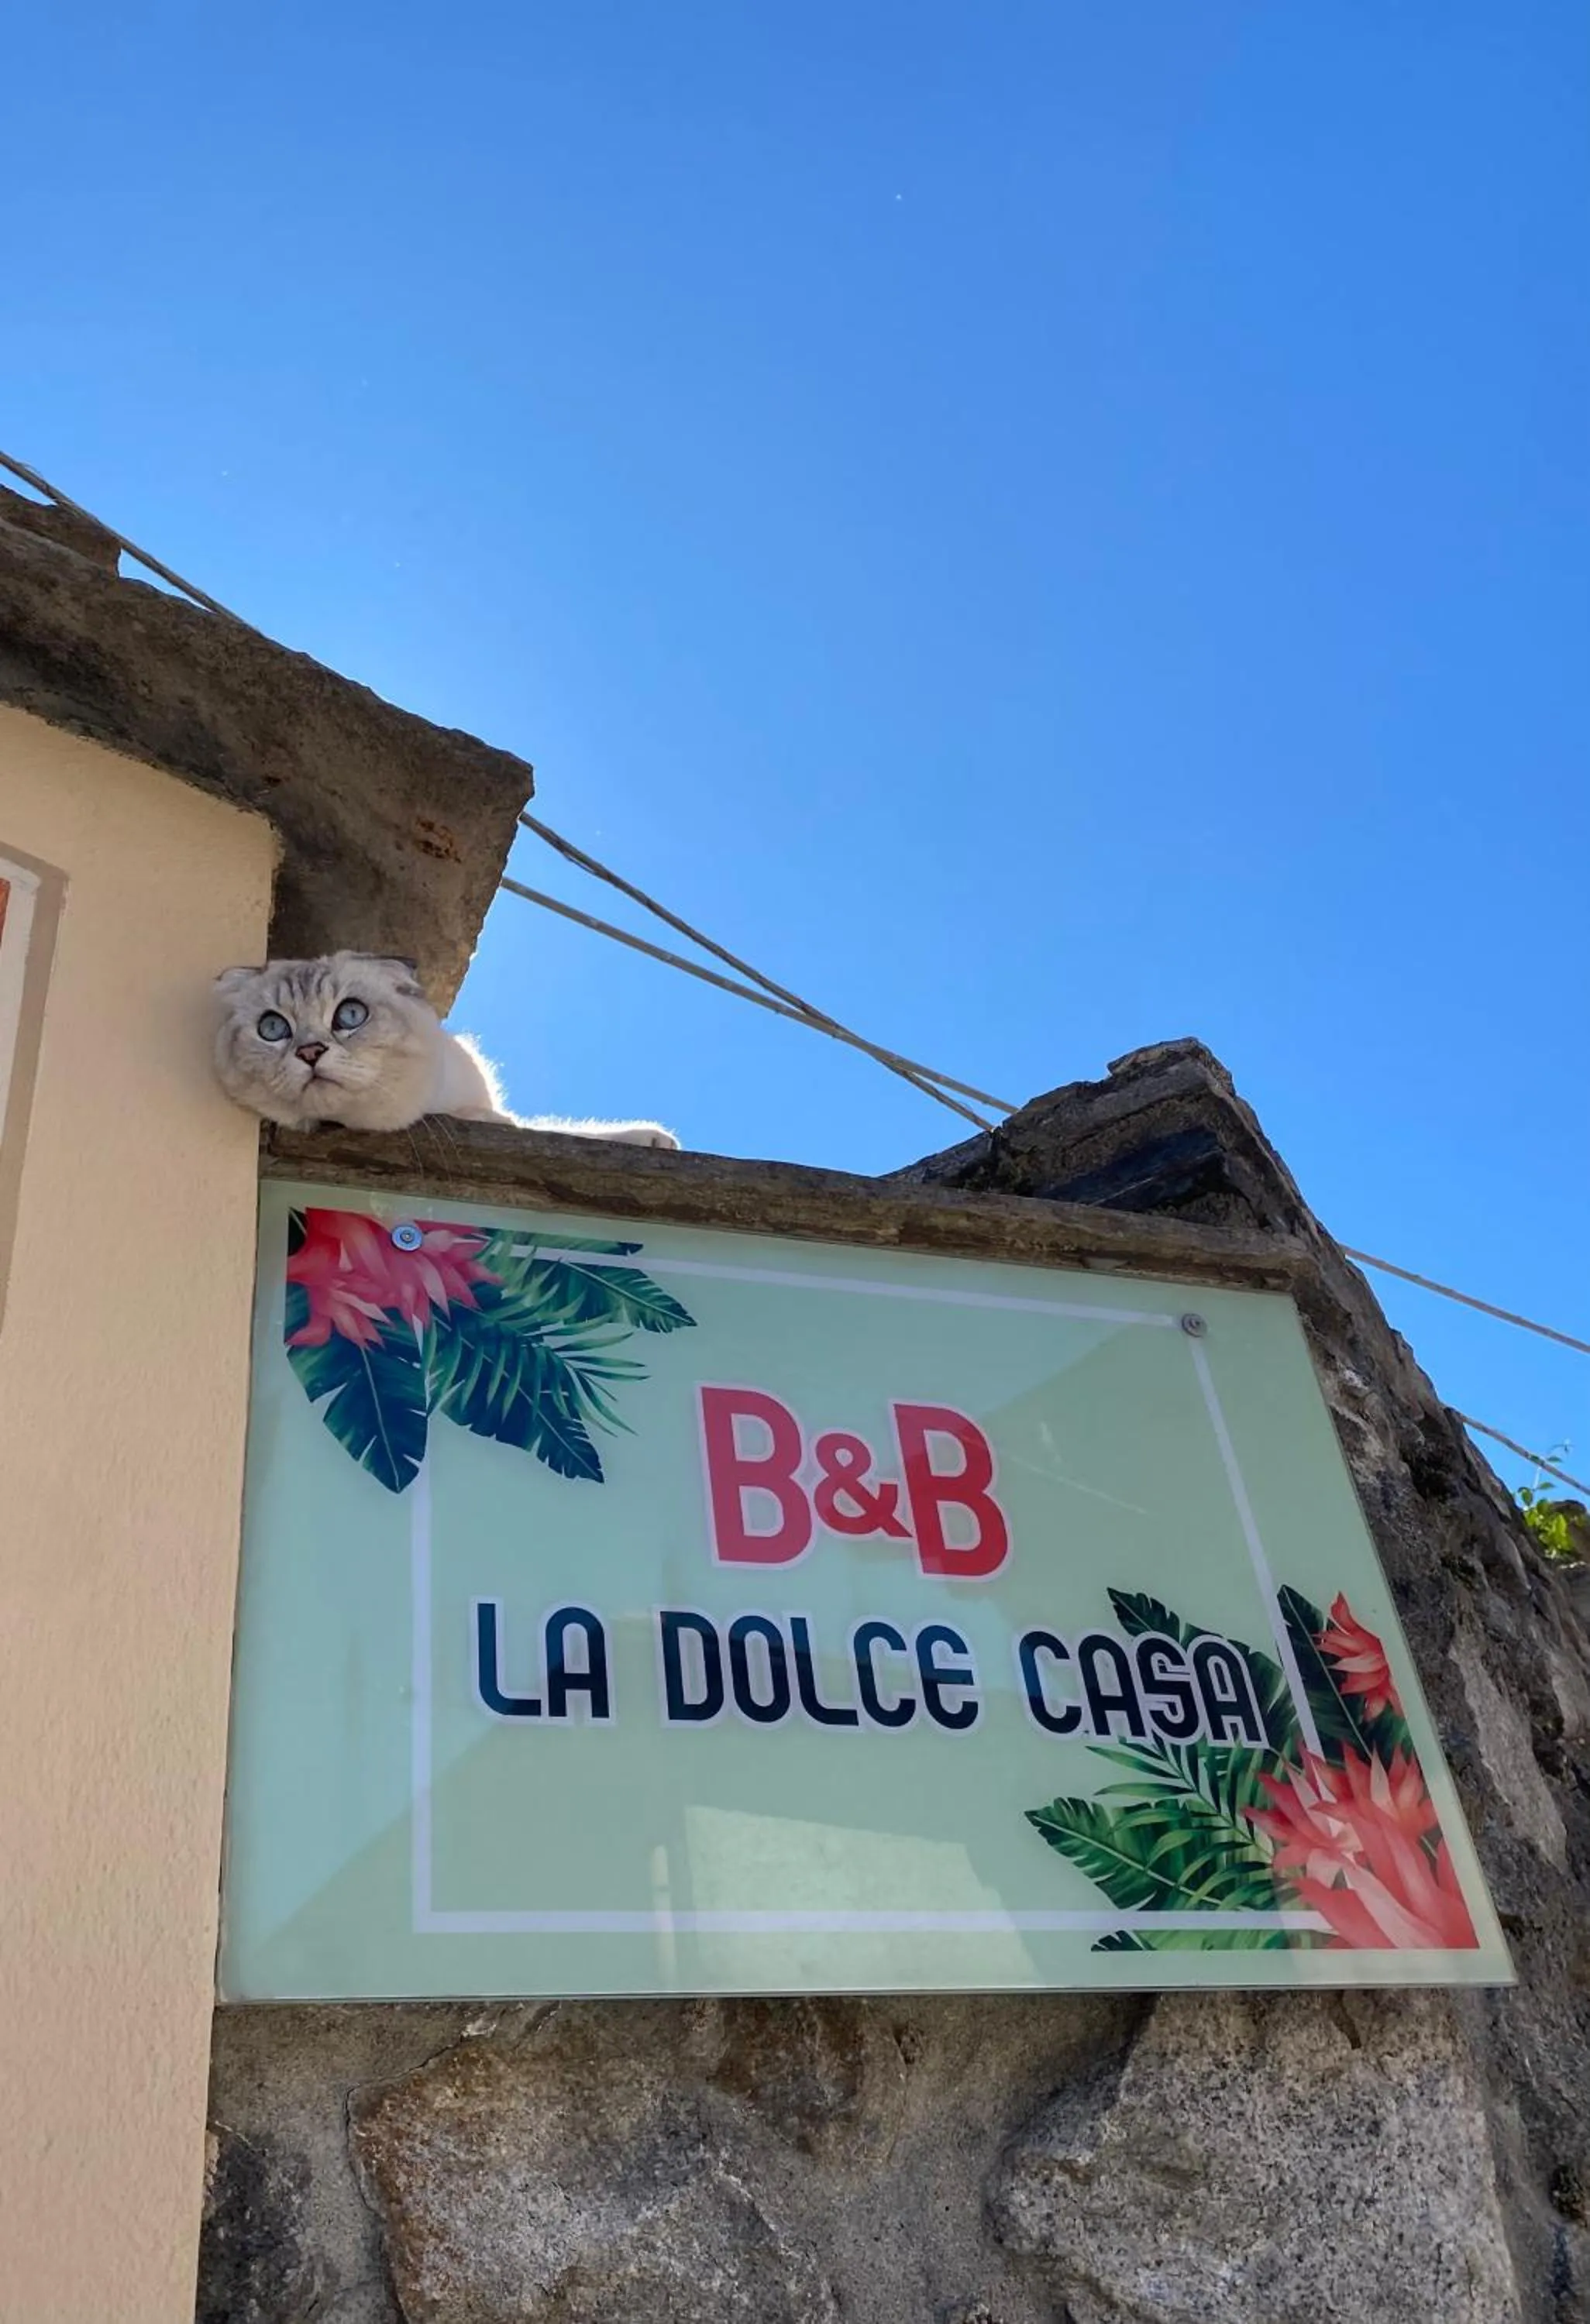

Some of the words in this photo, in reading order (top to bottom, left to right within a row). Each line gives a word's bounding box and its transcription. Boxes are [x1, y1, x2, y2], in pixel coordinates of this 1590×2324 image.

[700, 1386, 1009, 1576] B&B
[477, 1602, 611, 1718] LA
[660, 1611, 979, 1730] DOLCE
[1018, 1631, 1268, 1744] CASA
